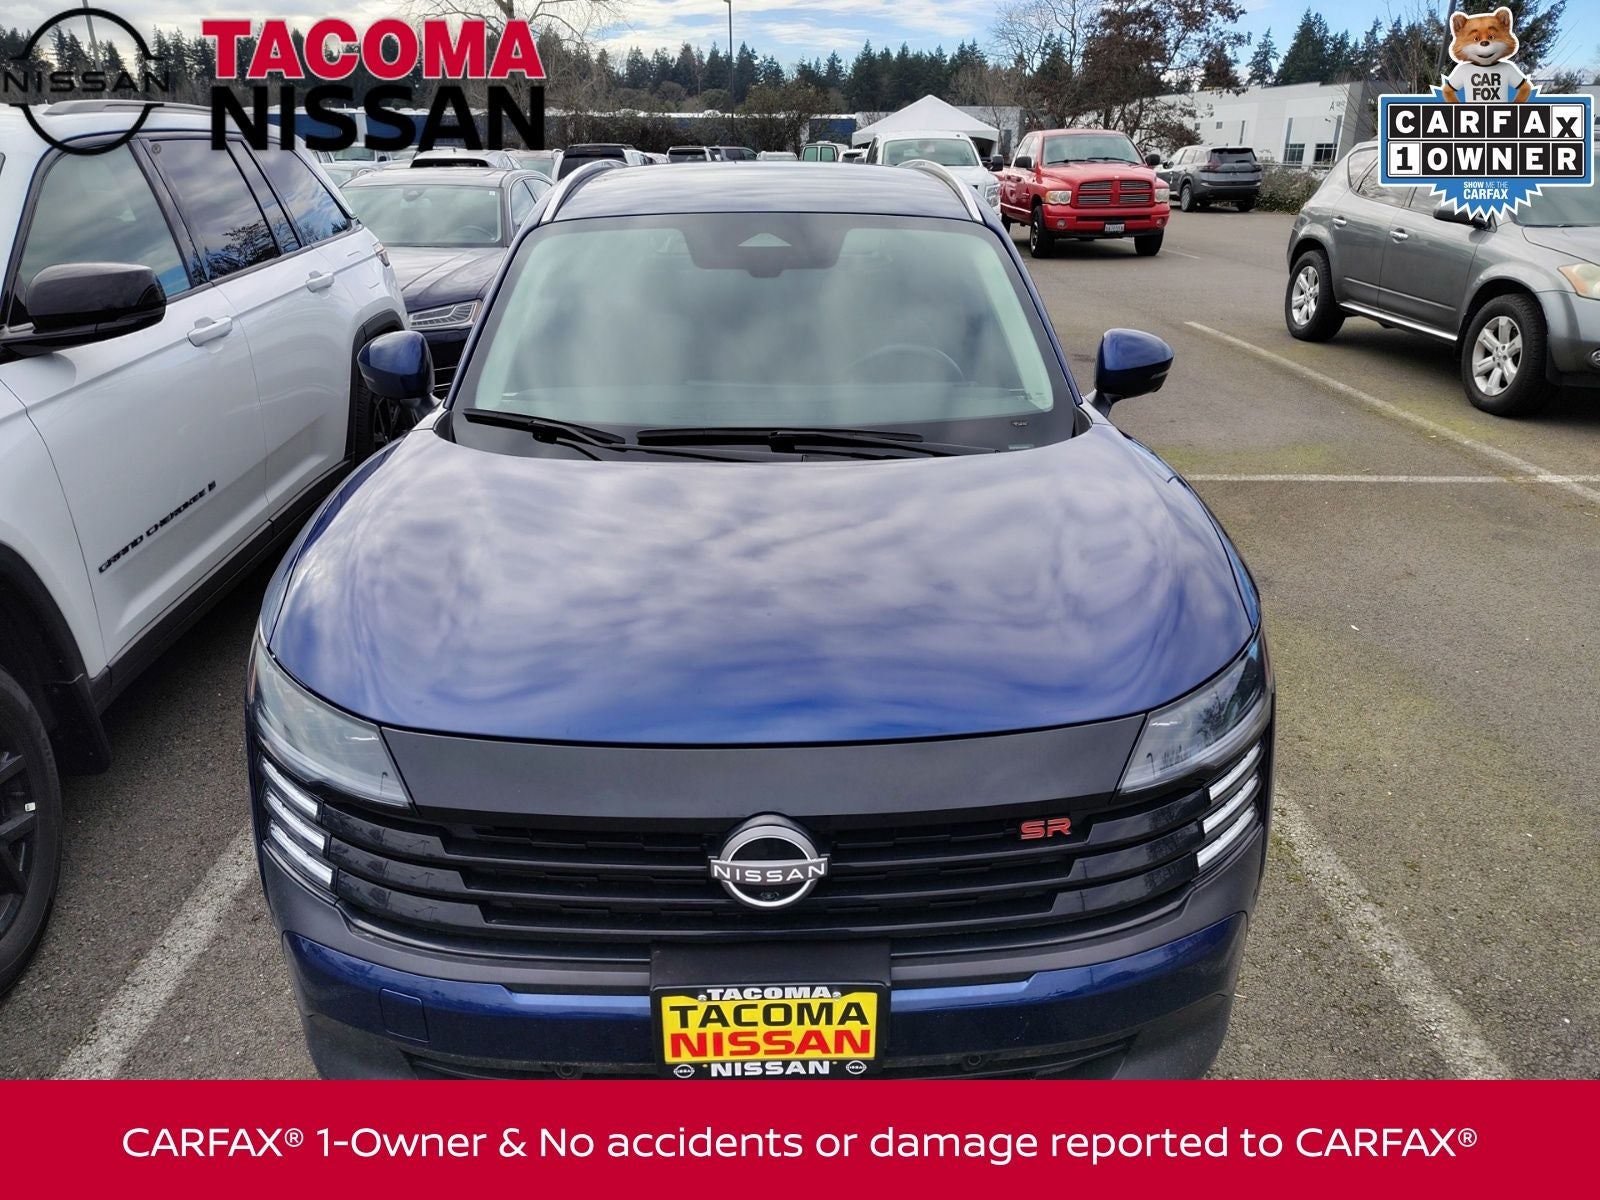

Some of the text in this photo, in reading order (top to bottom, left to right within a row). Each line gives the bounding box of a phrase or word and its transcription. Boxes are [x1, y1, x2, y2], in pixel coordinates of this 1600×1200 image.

[98, 534, 144, 574] GRAND
[1020, 817, 1072, 840] SR
[713, 862, 826, 883] NISSAN
[706, 986, 832, 1001] TACOMA
[669, 1002, 870, 1029] TACOMA
[670, 1029, 871, 1058] NISSAN
[710, 1060, 830, 1077] NISSAN
